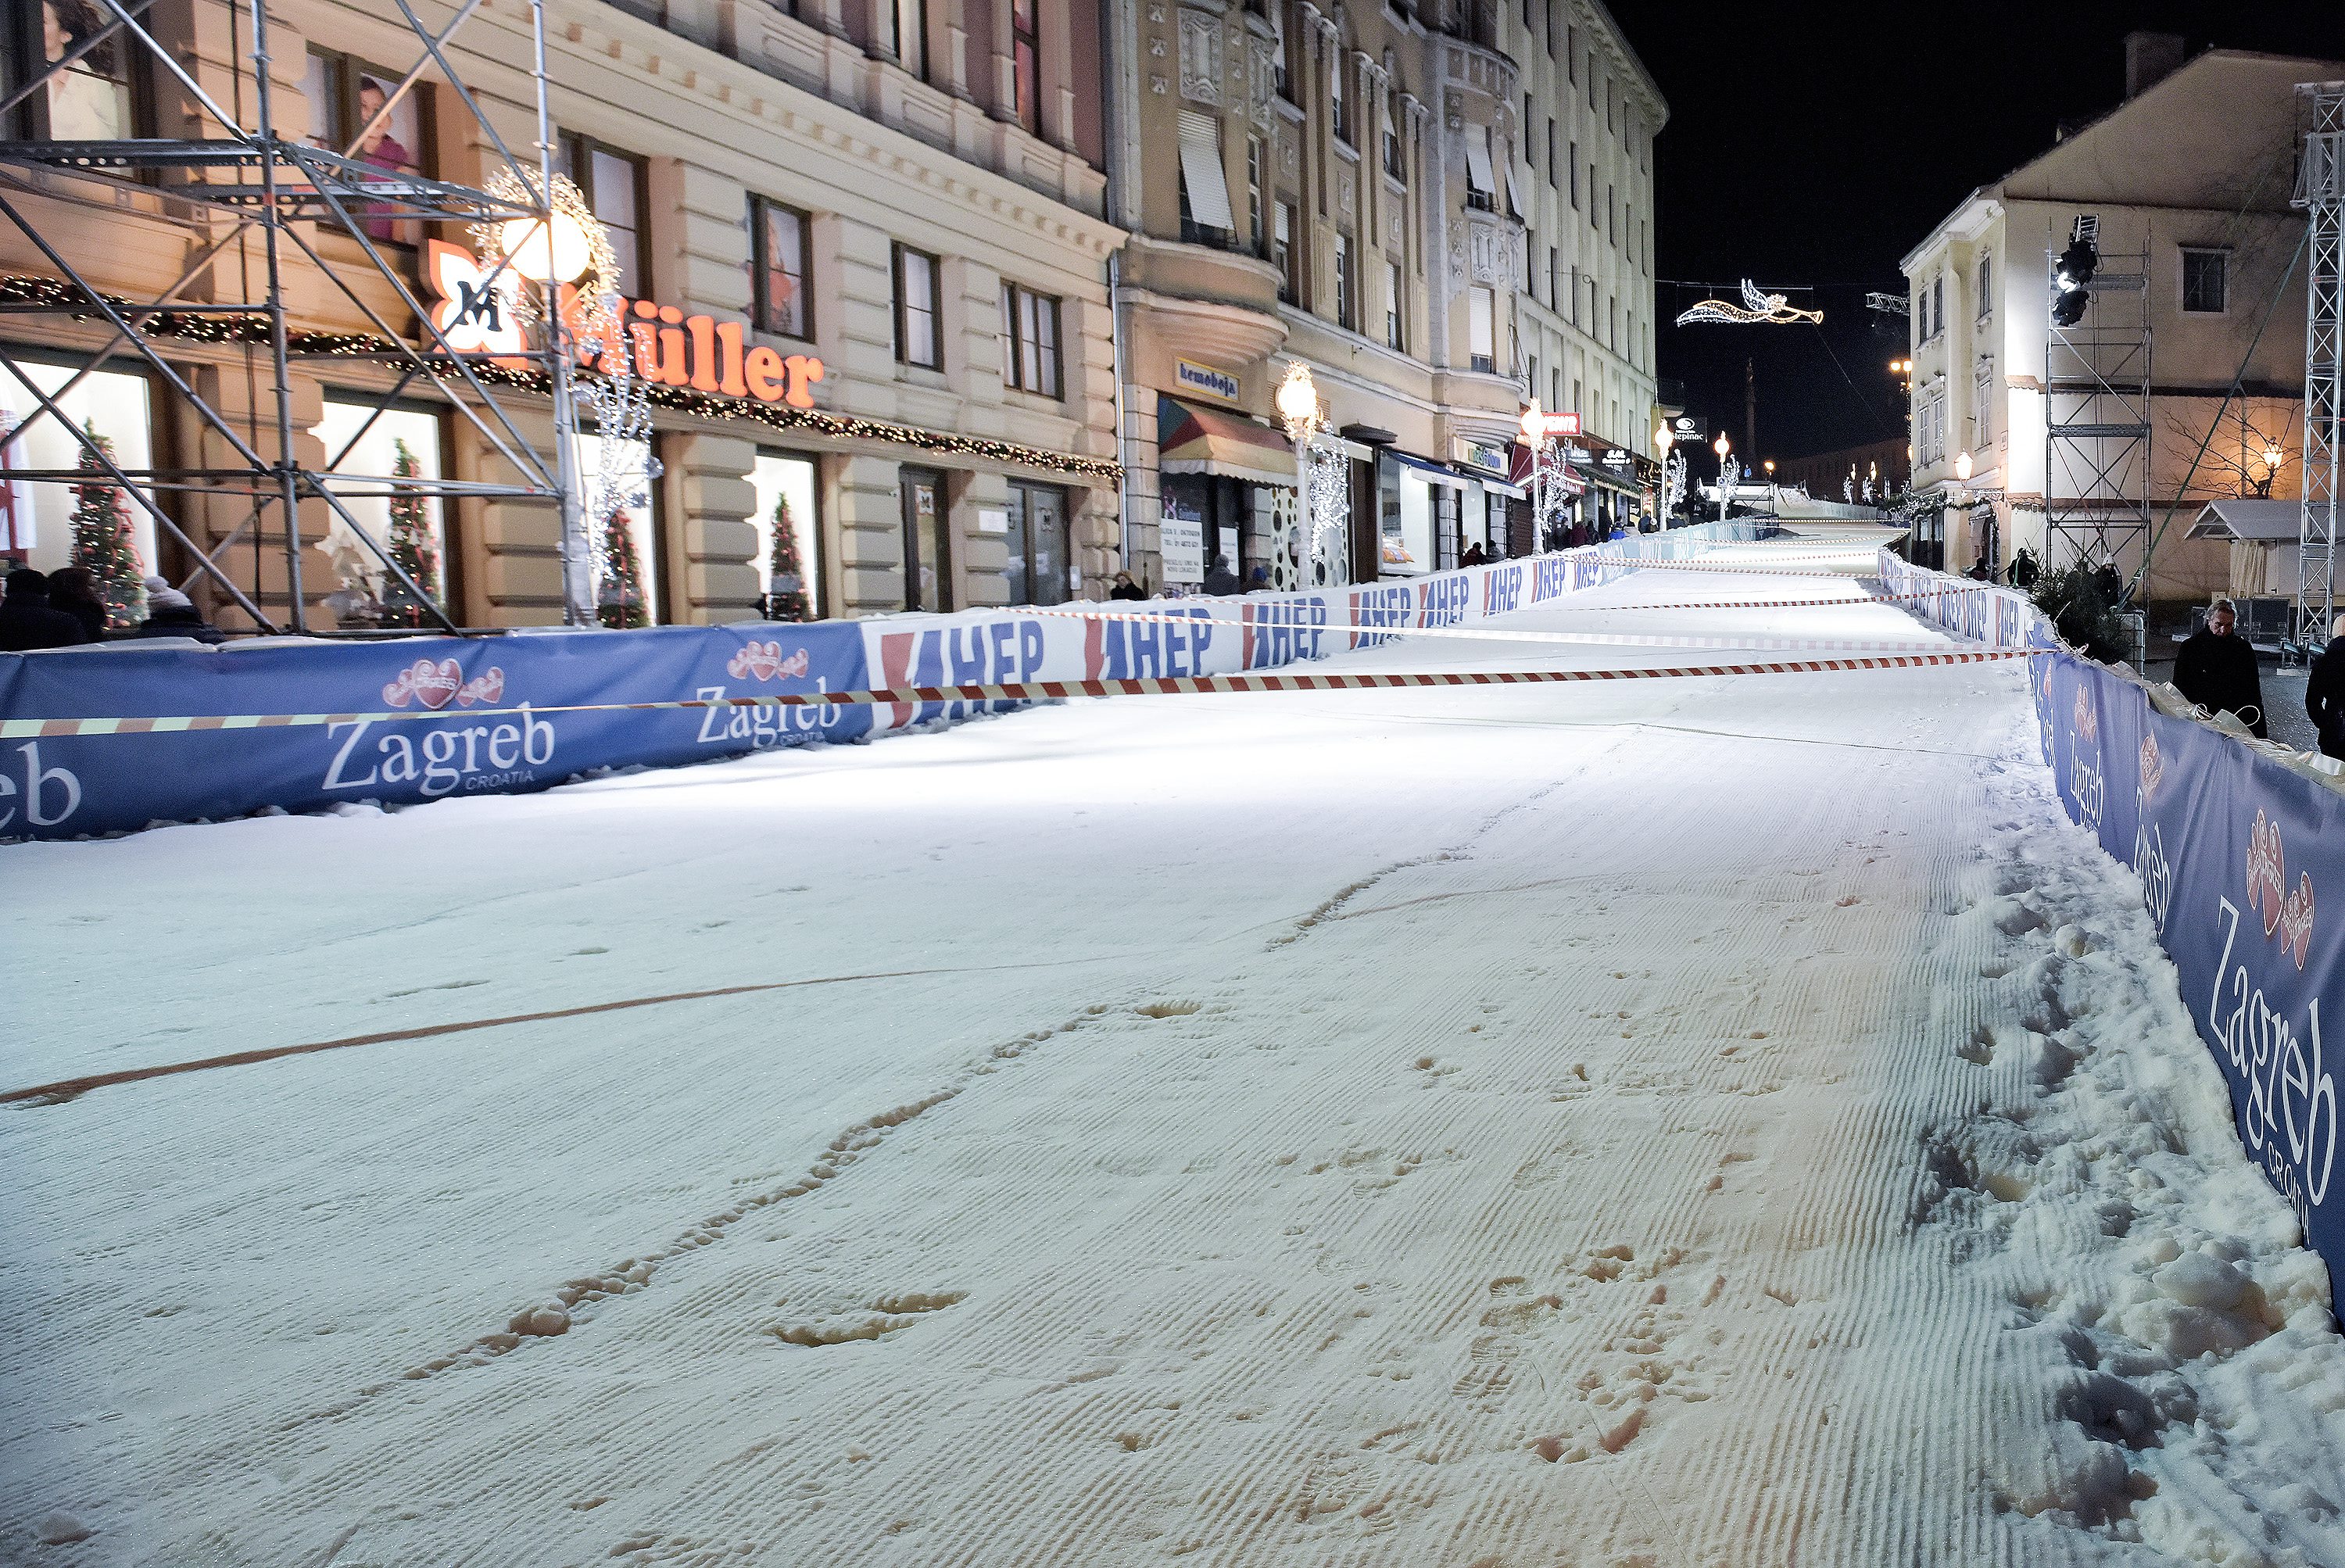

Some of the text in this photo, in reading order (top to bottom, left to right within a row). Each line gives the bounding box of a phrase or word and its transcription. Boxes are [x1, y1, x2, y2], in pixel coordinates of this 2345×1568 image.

[950, 620, 1044, 720] HEP
[1130, 607, 1212, 680] HEP
[321, 701, 556, 797] Zagreb
[696, 676, 842, 748] Zagreb
[2069, 729, 2104, 827] Zagreb
[2210, 894, 2337, 1206] Zagreb
[2268, 1140, 2311, 1245] CROATIA
